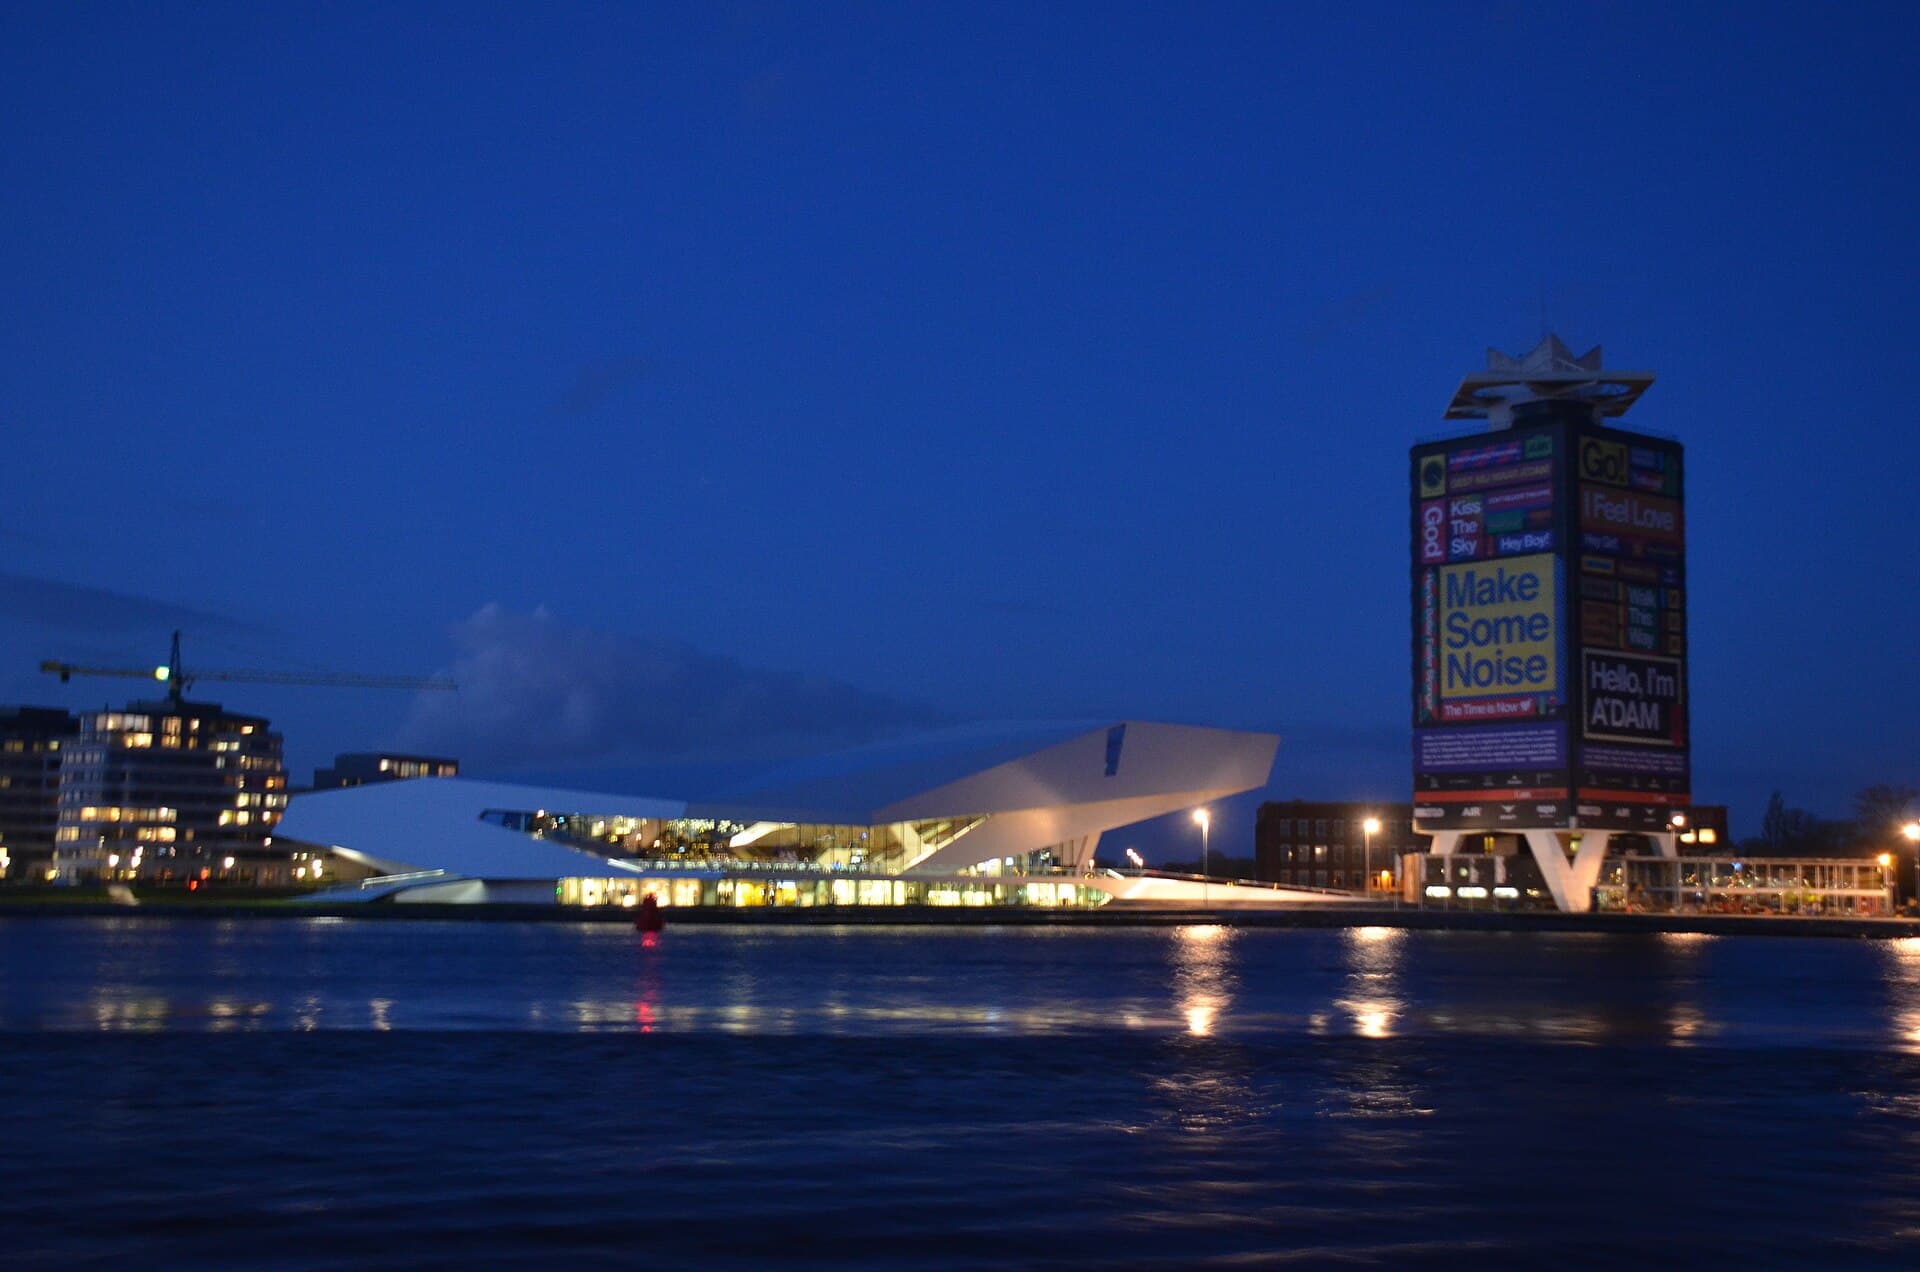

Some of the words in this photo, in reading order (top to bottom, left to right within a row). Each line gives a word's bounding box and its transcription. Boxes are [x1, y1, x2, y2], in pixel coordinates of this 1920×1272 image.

[1583, 441, 1625, 481] Go!
[1450, 501, 1481, 516] Kiss
[1450, 519, 1477, 535] The
[1593, 492, 1629, 523] Feel
[1632, 499, 1674, 531] Love
[1424, 506, 1443, 558] God
[1451, 537, 1477, 555] Sky
[1500, 537, 1522, 551] Hey
[1446, 567, 1539, 608] Make
[1447, 611, 1548, 649] Some
[1447, 649, 1547, 689] Noise
[1591, 660, 1643, 697] Hello,
[1648, 667, 1674, 697] I'm
[1445, 705, 1462, 716] The
[1464, 703, 1485, 714] Time
[1497, 700, 1517, 712] Now
